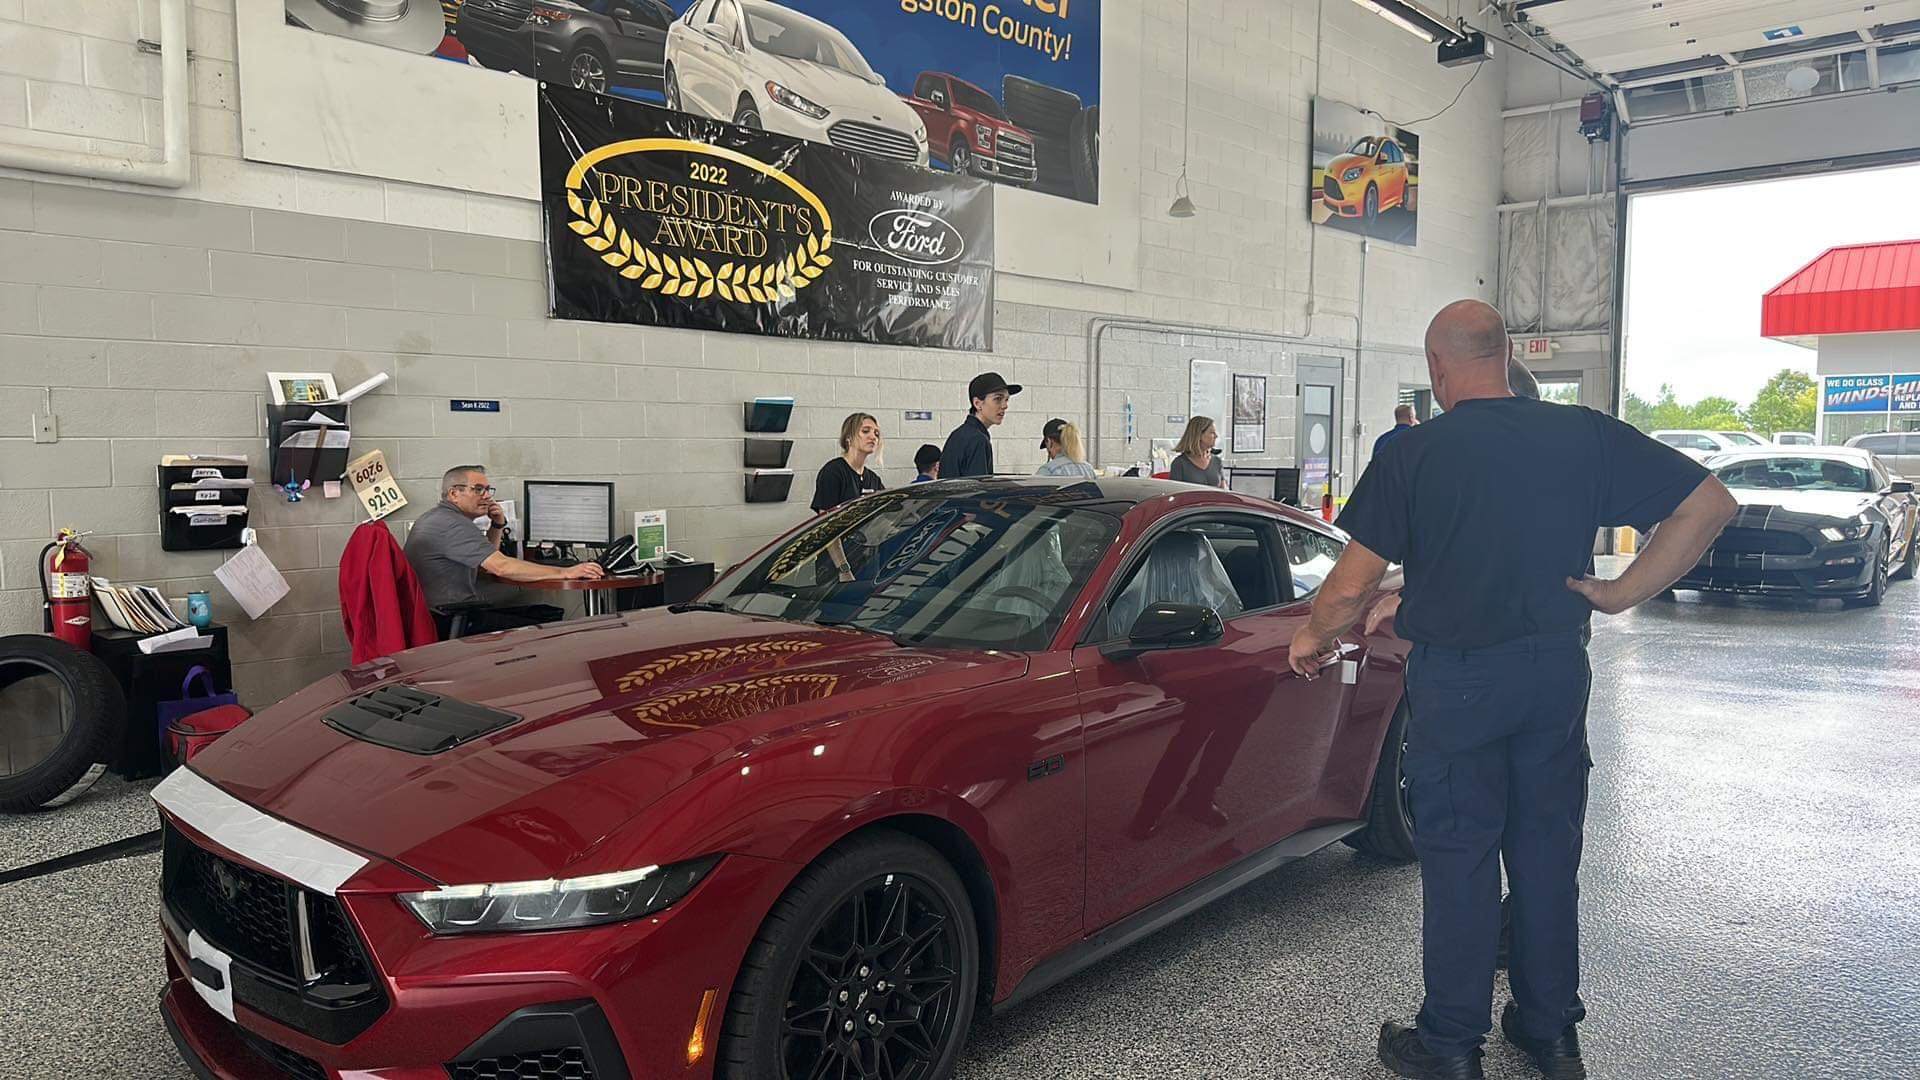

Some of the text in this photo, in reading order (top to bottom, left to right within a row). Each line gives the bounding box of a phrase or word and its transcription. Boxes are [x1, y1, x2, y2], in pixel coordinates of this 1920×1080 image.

[983, 4, 1072, 61] County!
[690, 162, 728, 185] 2022
[598, 172, 812, 236] PRESIDENT'S
[890, 190, 944, 210] AWARDED BY
[651, 216, 768, 258] AWARD
[888, 215, 946, 255] Ford
[853, 260, 979, 286] FOR OUTSTANDING CUSTOMER
[877, 278, 960, 297] SERVICE AND SALES
[889, 294, 951, 310] PERFORMANCE
[1529, 340, 1548, 353] EXIT
[1827, 378, 1884, 387] WE DO GLASS
[1828, 381, 1920, 406] WINDSHI
[368, 487, 399, 511] 9210
